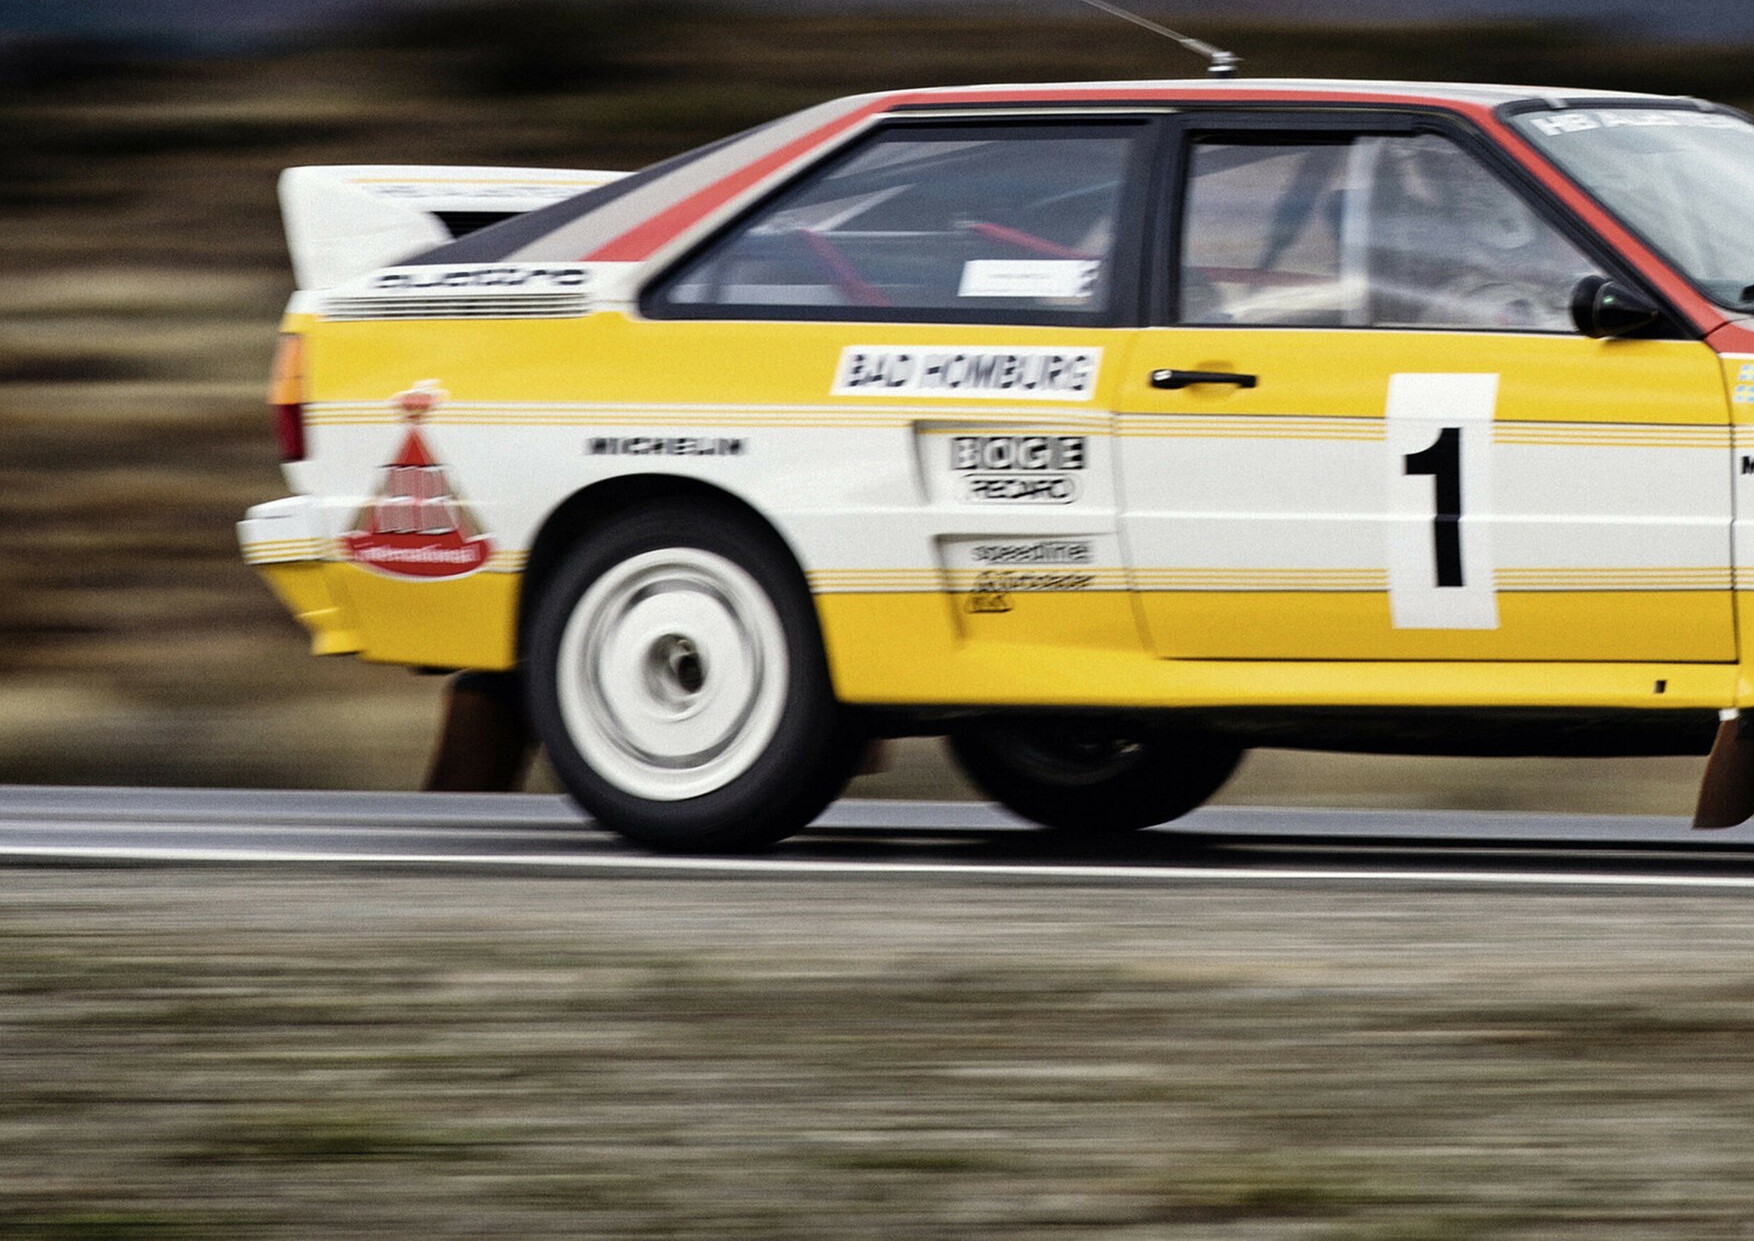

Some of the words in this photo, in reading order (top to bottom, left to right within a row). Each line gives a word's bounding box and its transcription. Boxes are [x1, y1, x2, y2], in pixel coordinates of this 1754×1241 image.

[848, 354, 912, 388] BAD
[919, 354, 1089, 391] HOMBURG
[951, 436, 1086, 470] BOGE
[1403, 426, 1464, 588] 1
